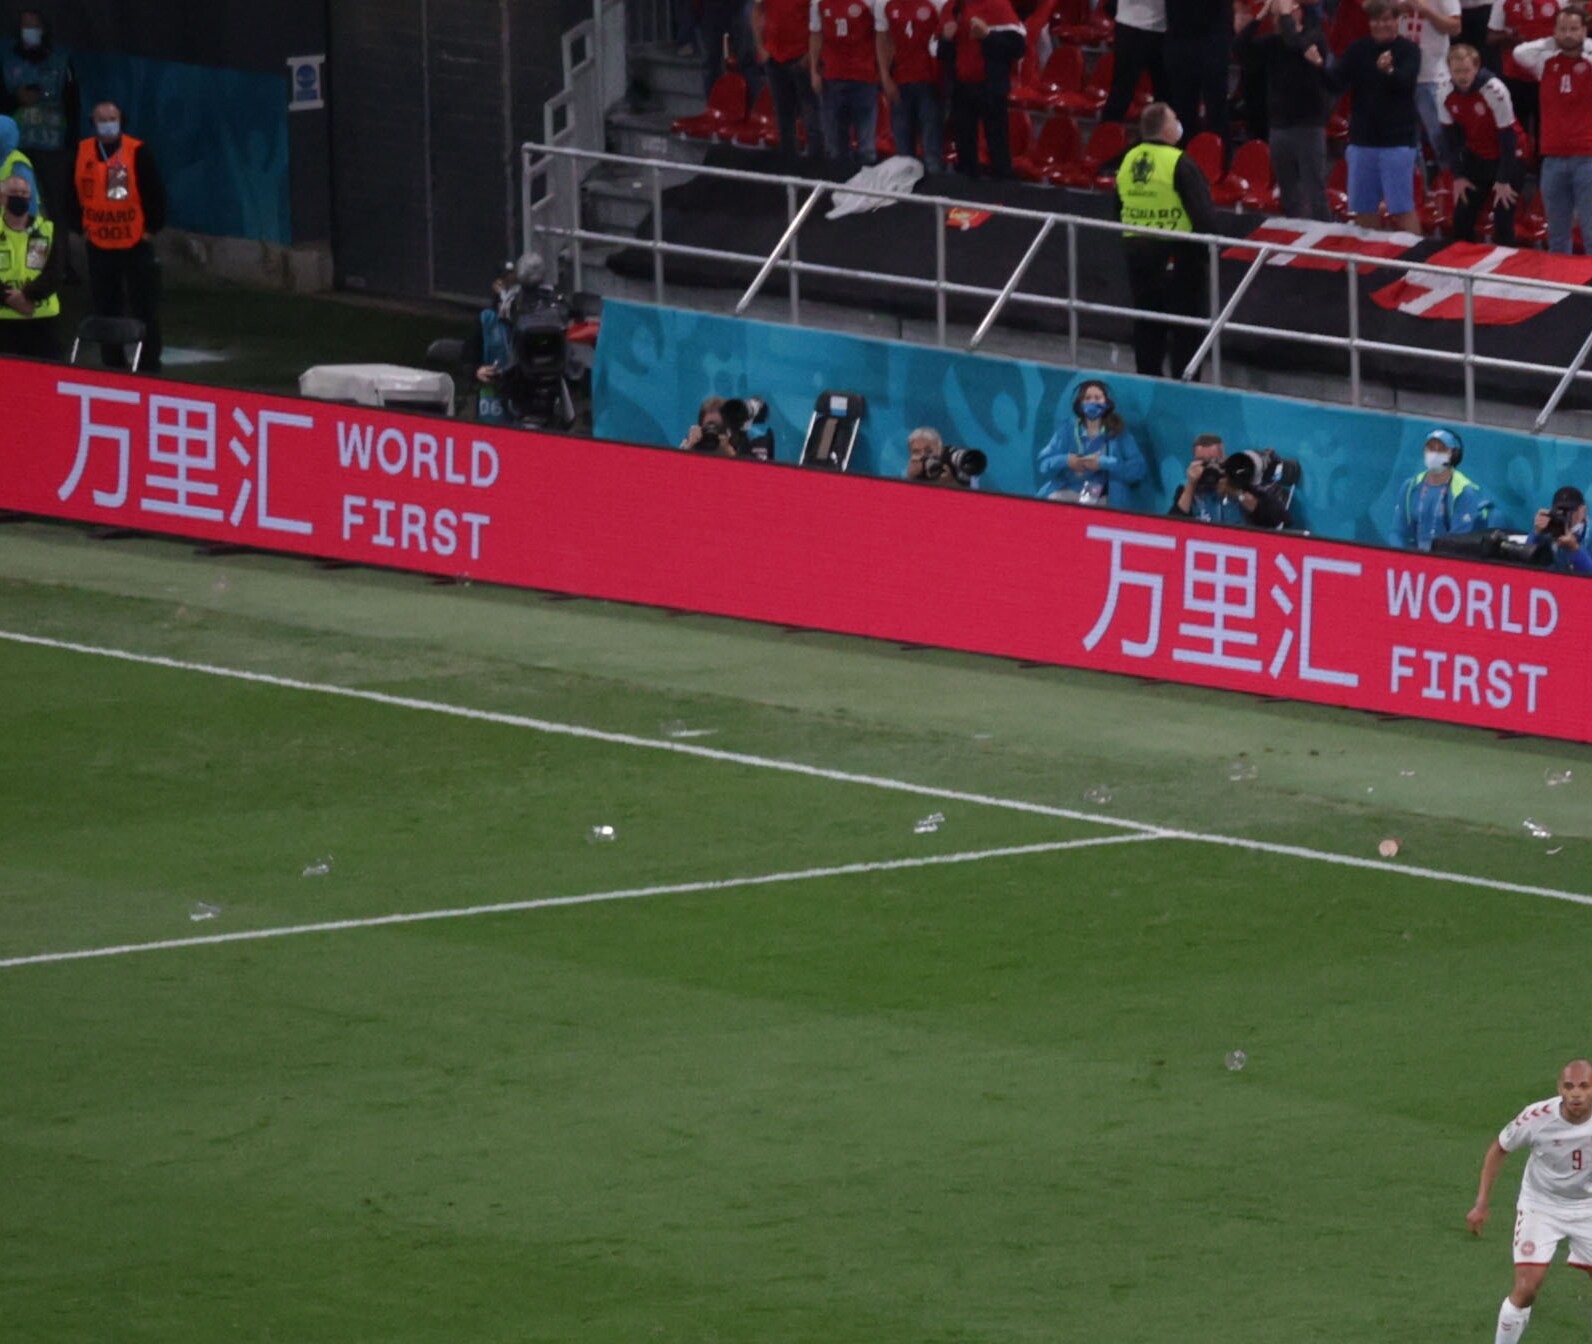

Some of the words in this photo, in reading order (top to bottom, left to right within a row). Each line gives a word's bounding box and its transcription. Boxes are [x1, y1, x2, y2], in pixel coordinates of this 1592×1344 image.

[58, 381, 314, 536] 万里汇
[337, 421, 499, 488] WORLD
[341, 494, 490, 560] FIRST
[1082, 524, 1361, 687] 万里汇
[1386, 568, 1559, 638] WORLD
[1390, 645, 1549, 713] FIRST
[1570, 1149, 1584, 1171] 9
